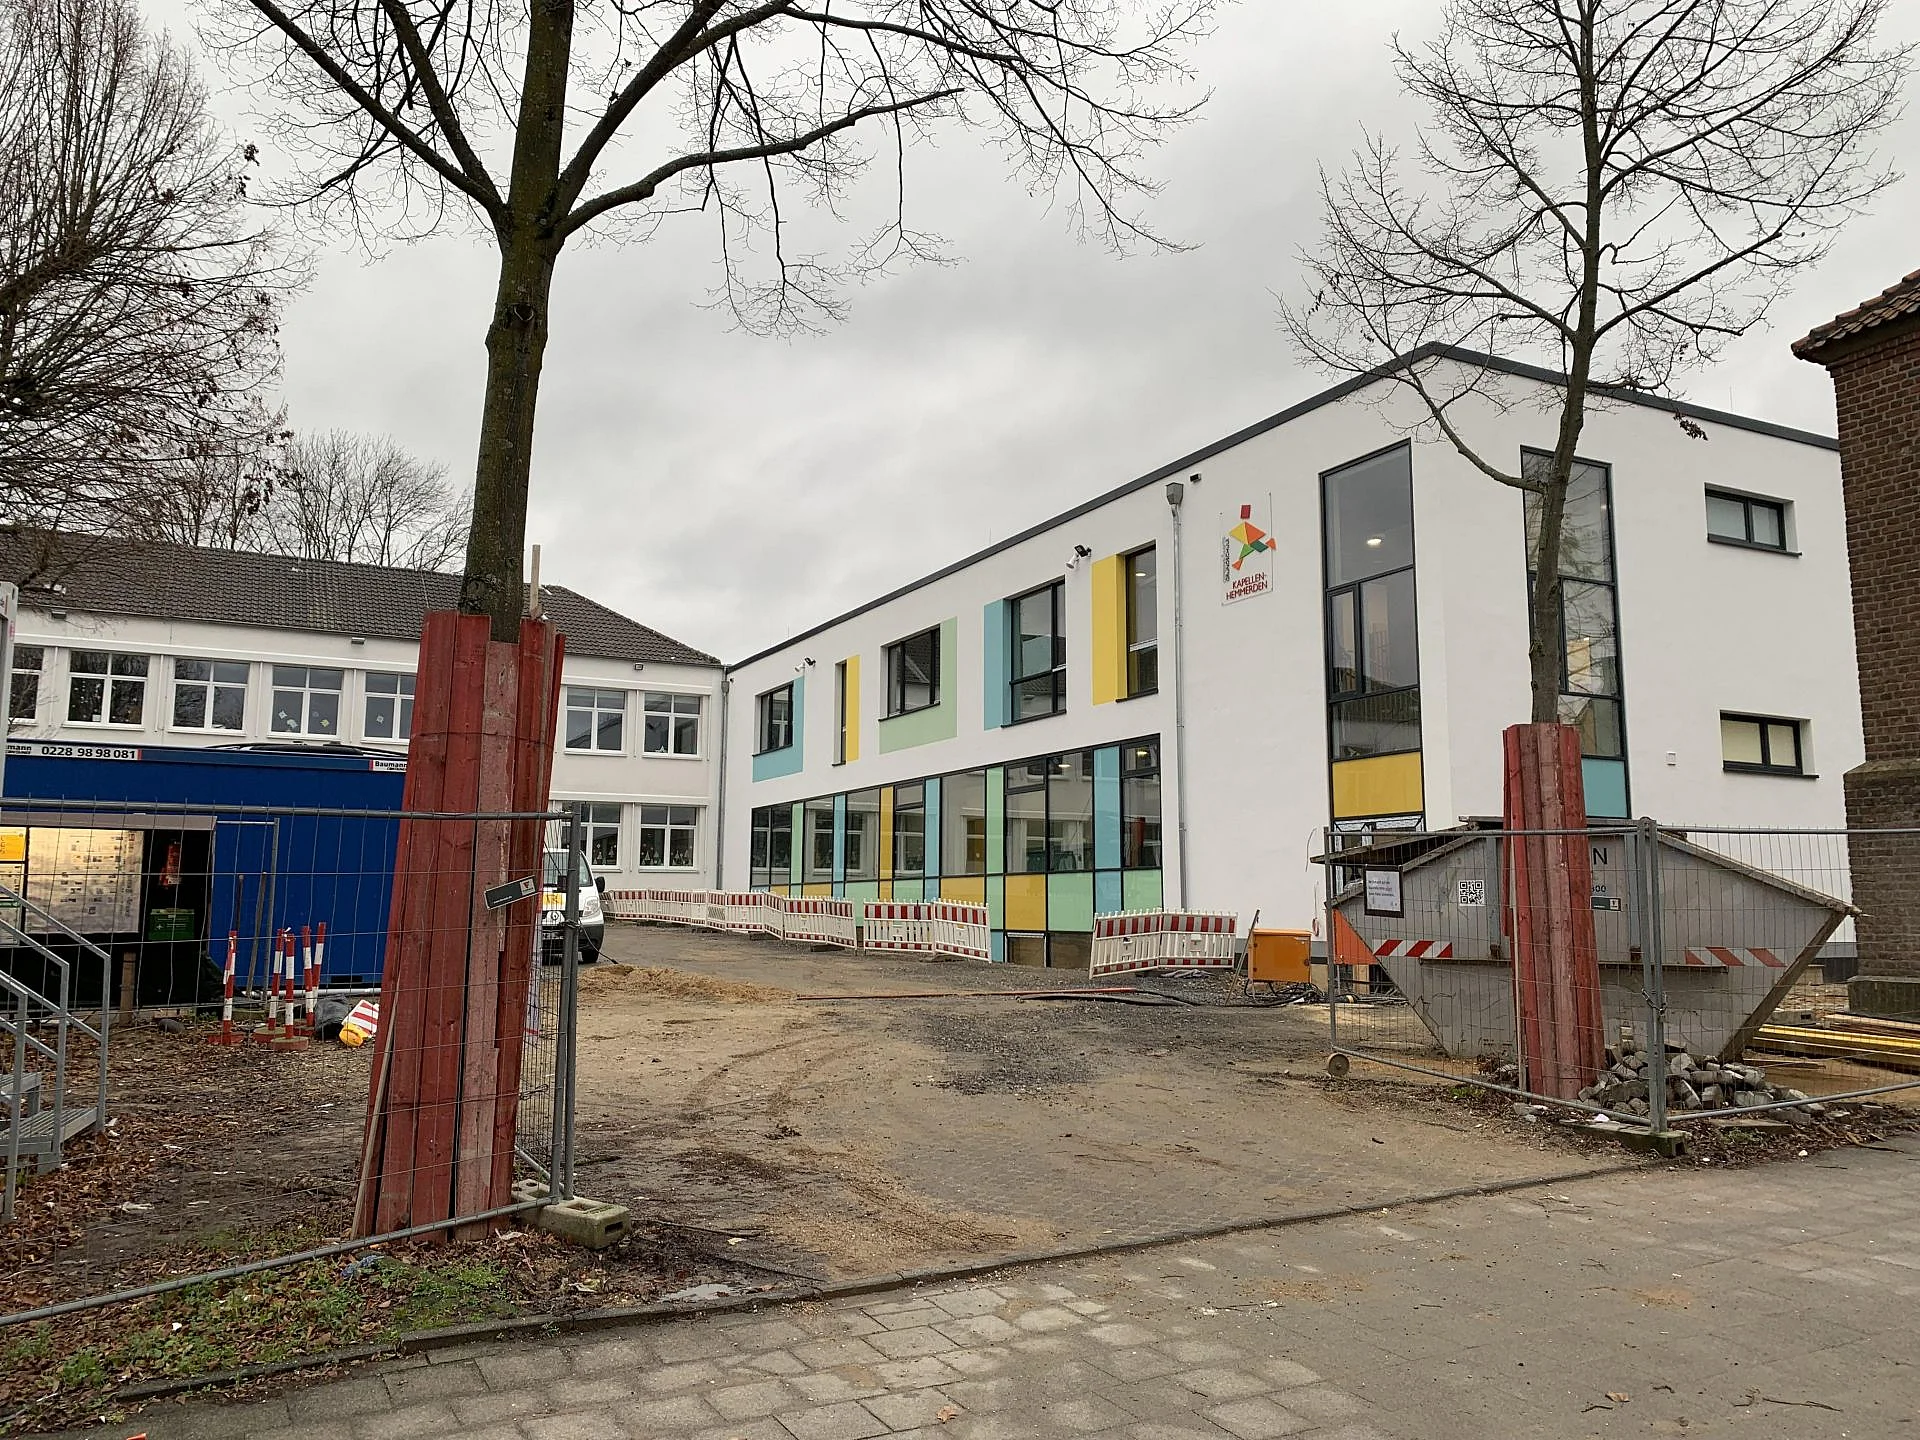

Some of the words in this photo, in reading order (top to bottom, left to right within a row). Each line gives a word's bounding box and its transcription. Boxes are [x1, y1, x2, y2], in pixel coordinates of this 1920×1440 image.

[1232, 572, 1267, 589] KAPELLEN-
[1226, 580, 1267, 600] HEMMERDEN
[42, 746, 73, 756] 0228
[77, 748, 93, 757] 98
[95, 748, 111, 758] 98
[113, 750, 135, 759] 081
